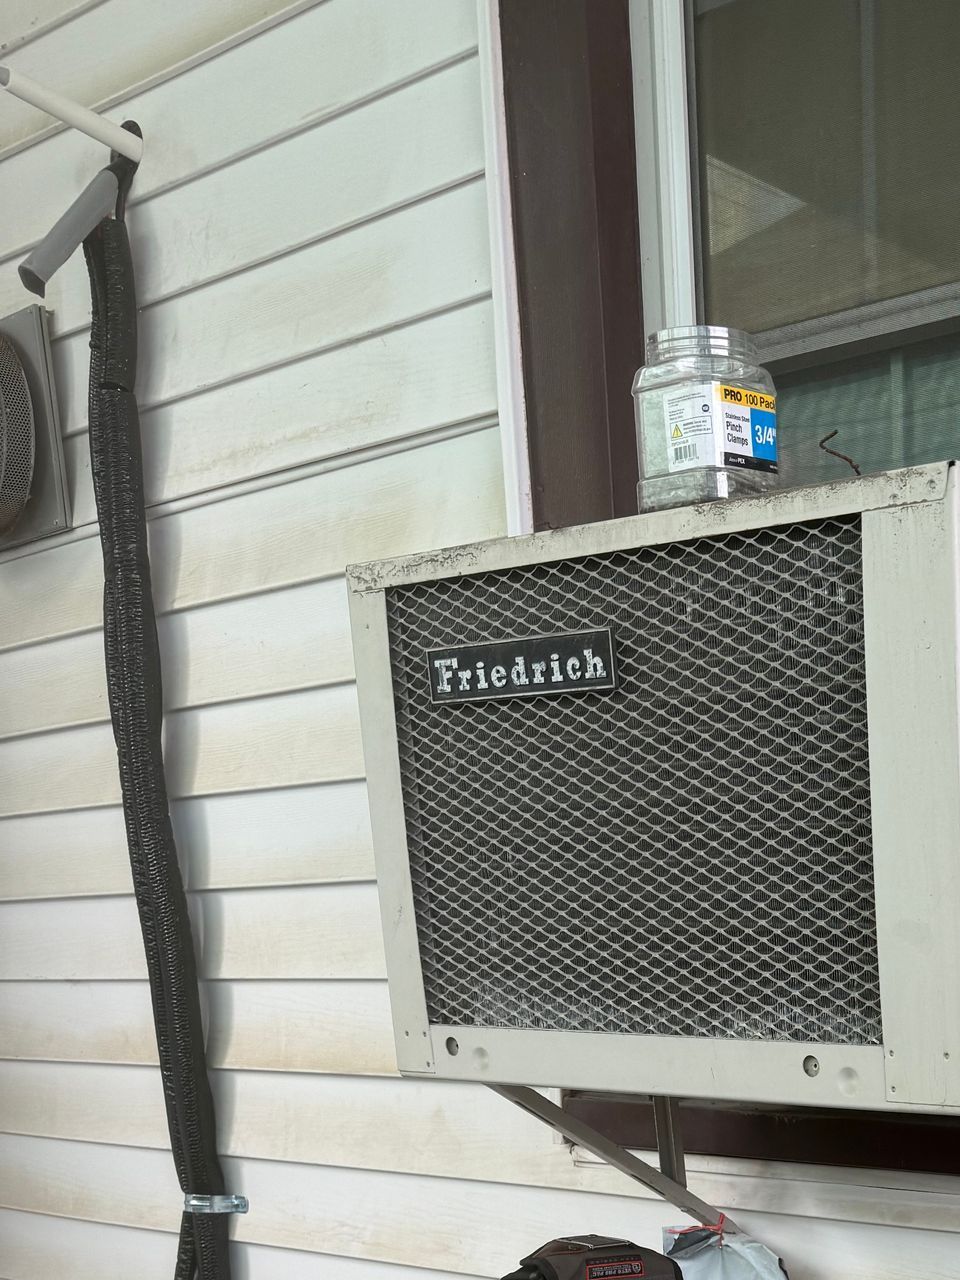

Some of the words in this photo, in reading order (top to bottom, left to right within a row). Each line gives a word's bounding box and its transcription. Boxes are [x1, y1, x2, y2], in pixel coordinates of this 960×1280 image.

[723, 388, 743, 402] PRO
[745, 394, 759, 406] 100
[726, 421, 743, 434] Pinch
[727, 432, 749, 447] Clamps
[433, 648, 607, 694] Friedrich
